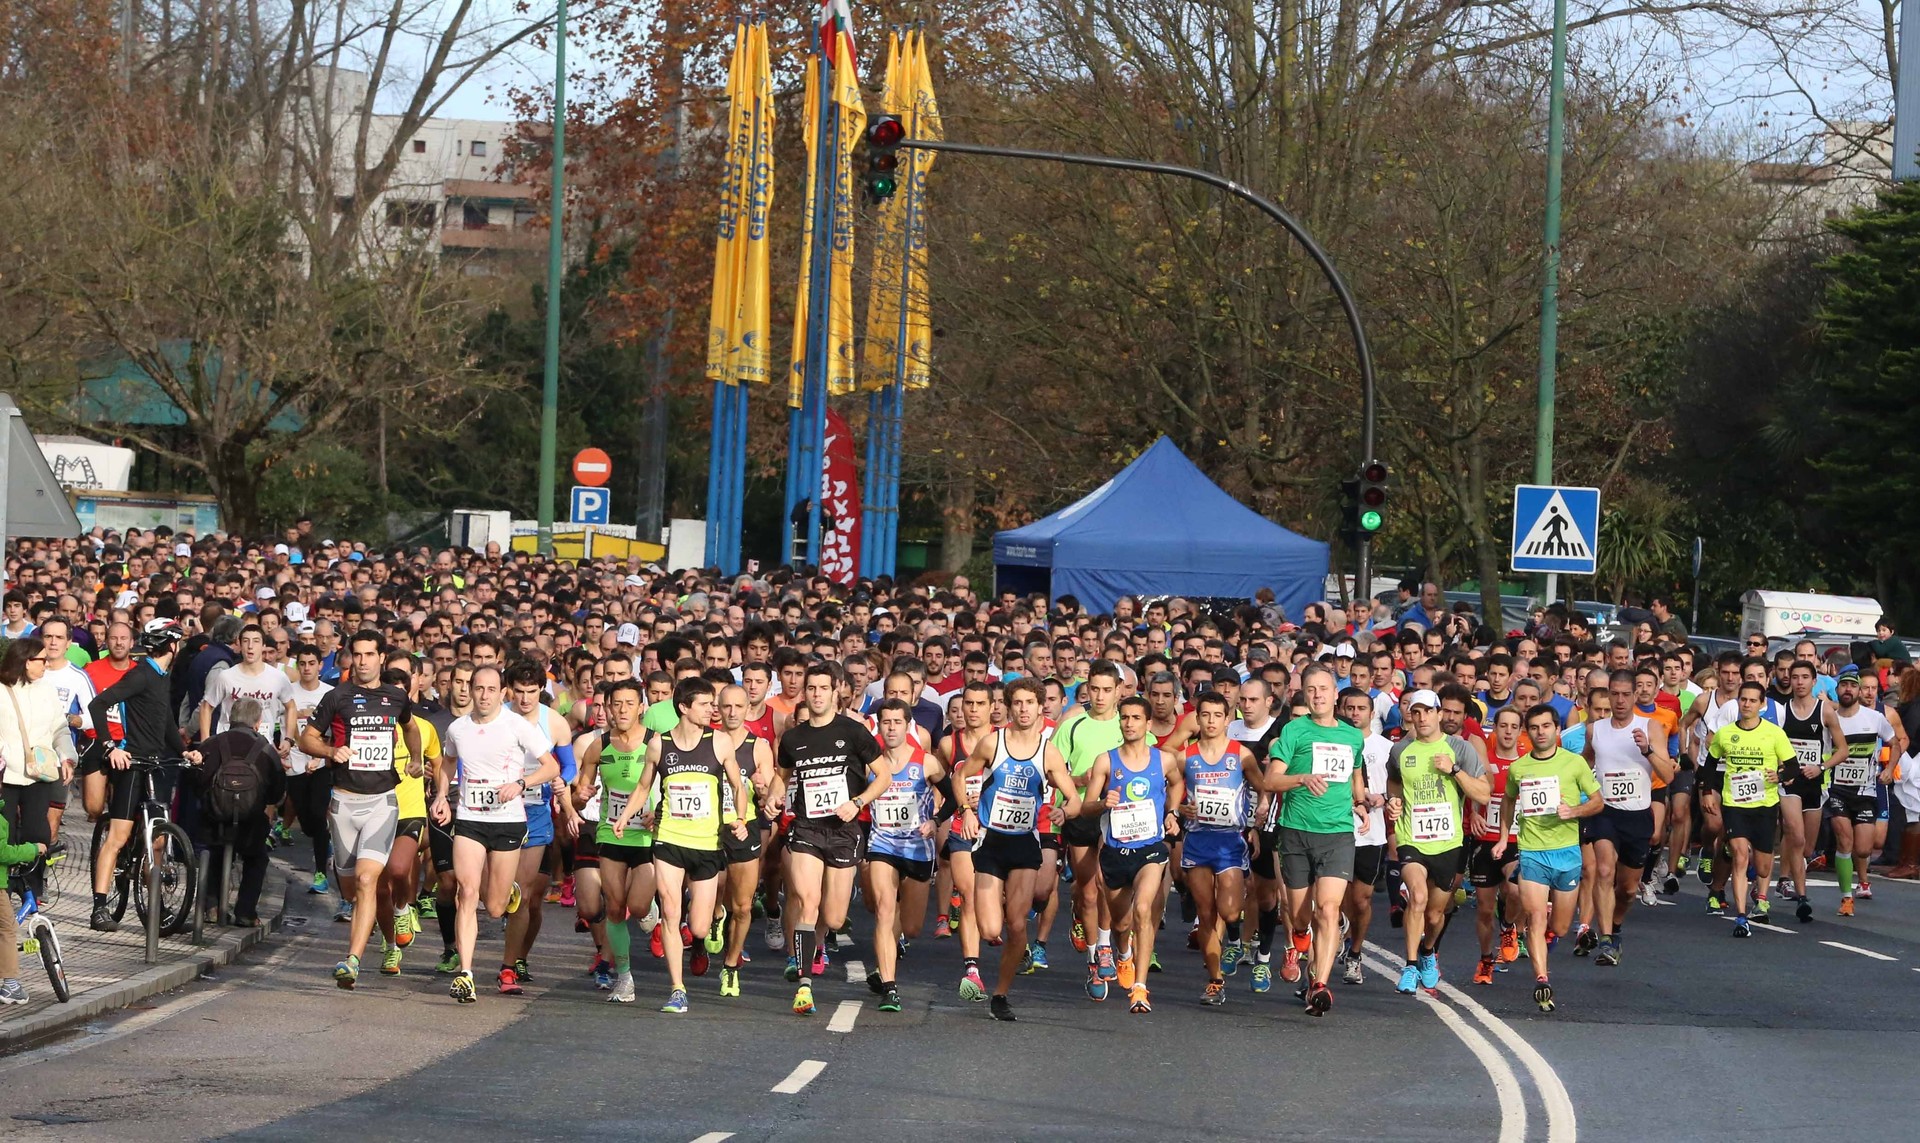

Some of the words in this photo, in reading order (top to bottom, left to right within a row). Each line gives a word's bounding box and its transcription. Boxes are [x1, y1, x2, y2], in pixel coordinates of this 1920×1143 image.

[750, 162, 769, 241] GETXO
[578, 491, 602, 521] P
[357, 746, 388, 761] 1022
[795, 754, 848, 768] BASQUE
[667, 764, 709, 775] DURANGO
[1324, 757, 1345, 772] 124
[799, 765, 844, 780] TRIBE
[1421, 773, 1434, 781] 2012
[1840, 768, 1865, 779] 1787
[1007, 776, 1026, 790] ISN
[1412, 780, 1435, 791] BILBAO
[1612, 782, 1634, 796] 520
[1738, 782, 1758, 797] 539
[814, 790, 839, 808] 247
[1413, 789, 1436, 801] NIGHT
[1531, 791, 1547, 806] 60
[677, 796, 702, 811] 179
[1198, 800, 1230, 816] 1575
[885, 806, 909, 821] 118
[998, 808, 1030, 824] 1782
[1131, 812, 1136, 822] 1
[1121, 821, 1147, 829] HASSAN
[1417, 817, 1450, 833] 1478
